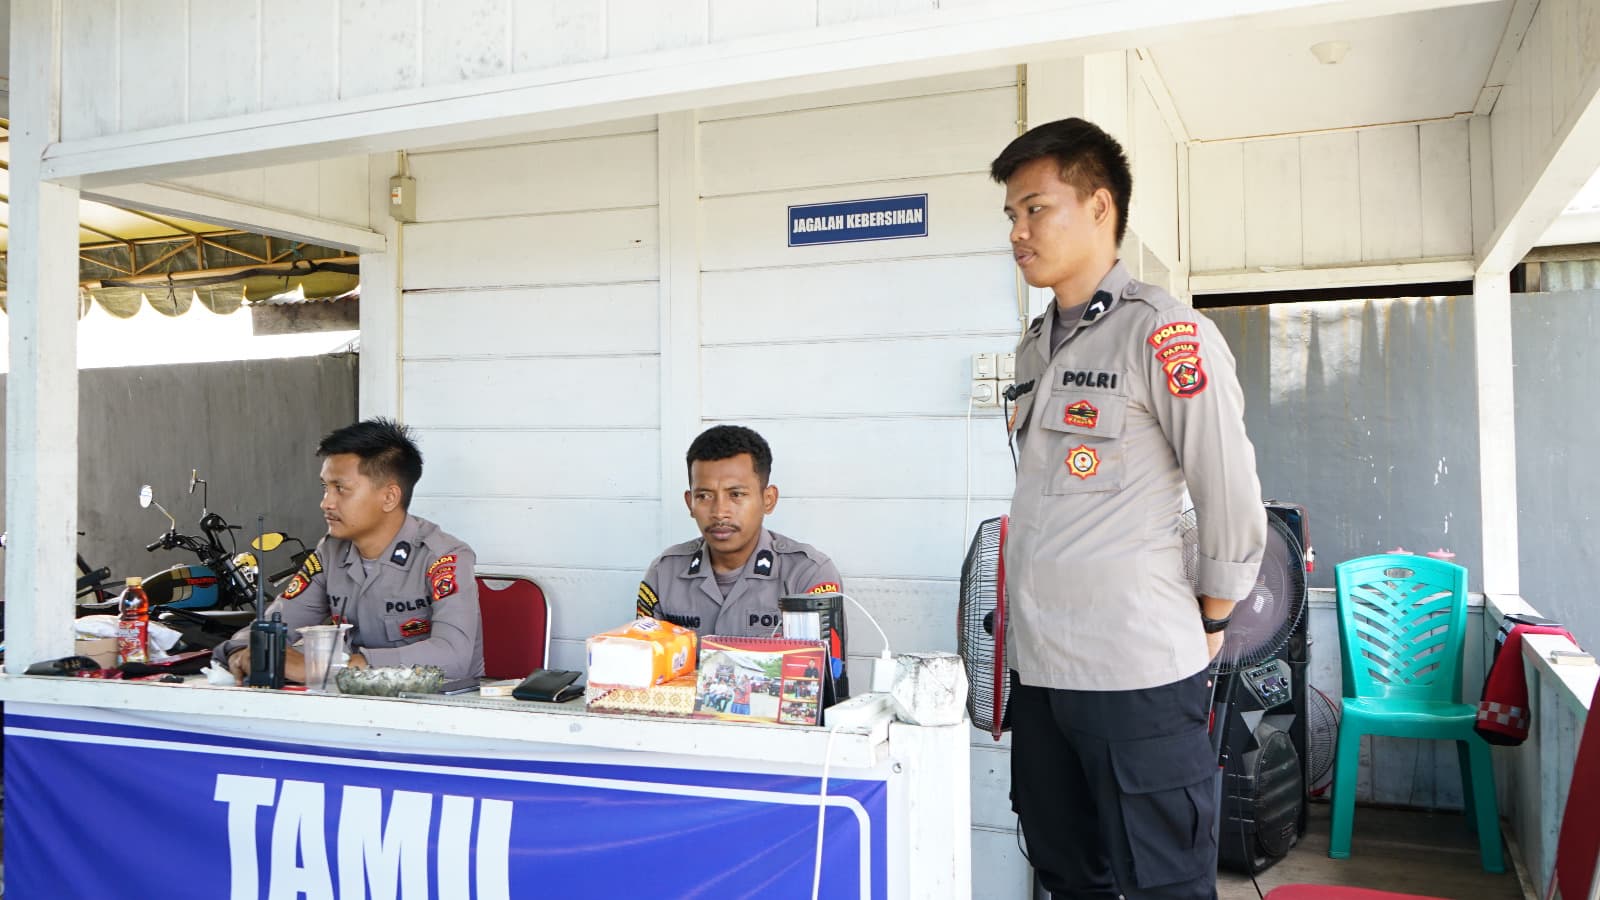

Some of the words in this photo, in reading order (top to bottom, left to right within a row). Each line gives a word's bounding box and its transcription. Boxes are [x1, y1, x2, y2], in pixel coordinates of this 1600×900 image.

[792, 214, 844, 233] JAGALAH
[846, 208, 923, 229] KEBERSIHAN
[1153, 324, 1195, 345] POLDA
[1162, 344, 1195, 358] PAPUA
[1062, 370, 1117, 389] POLRI
[810, 584, 837, 595] OLDA
[386, 595, 433, 613] POLRI
[213, 773, 514, 900] TAMU
